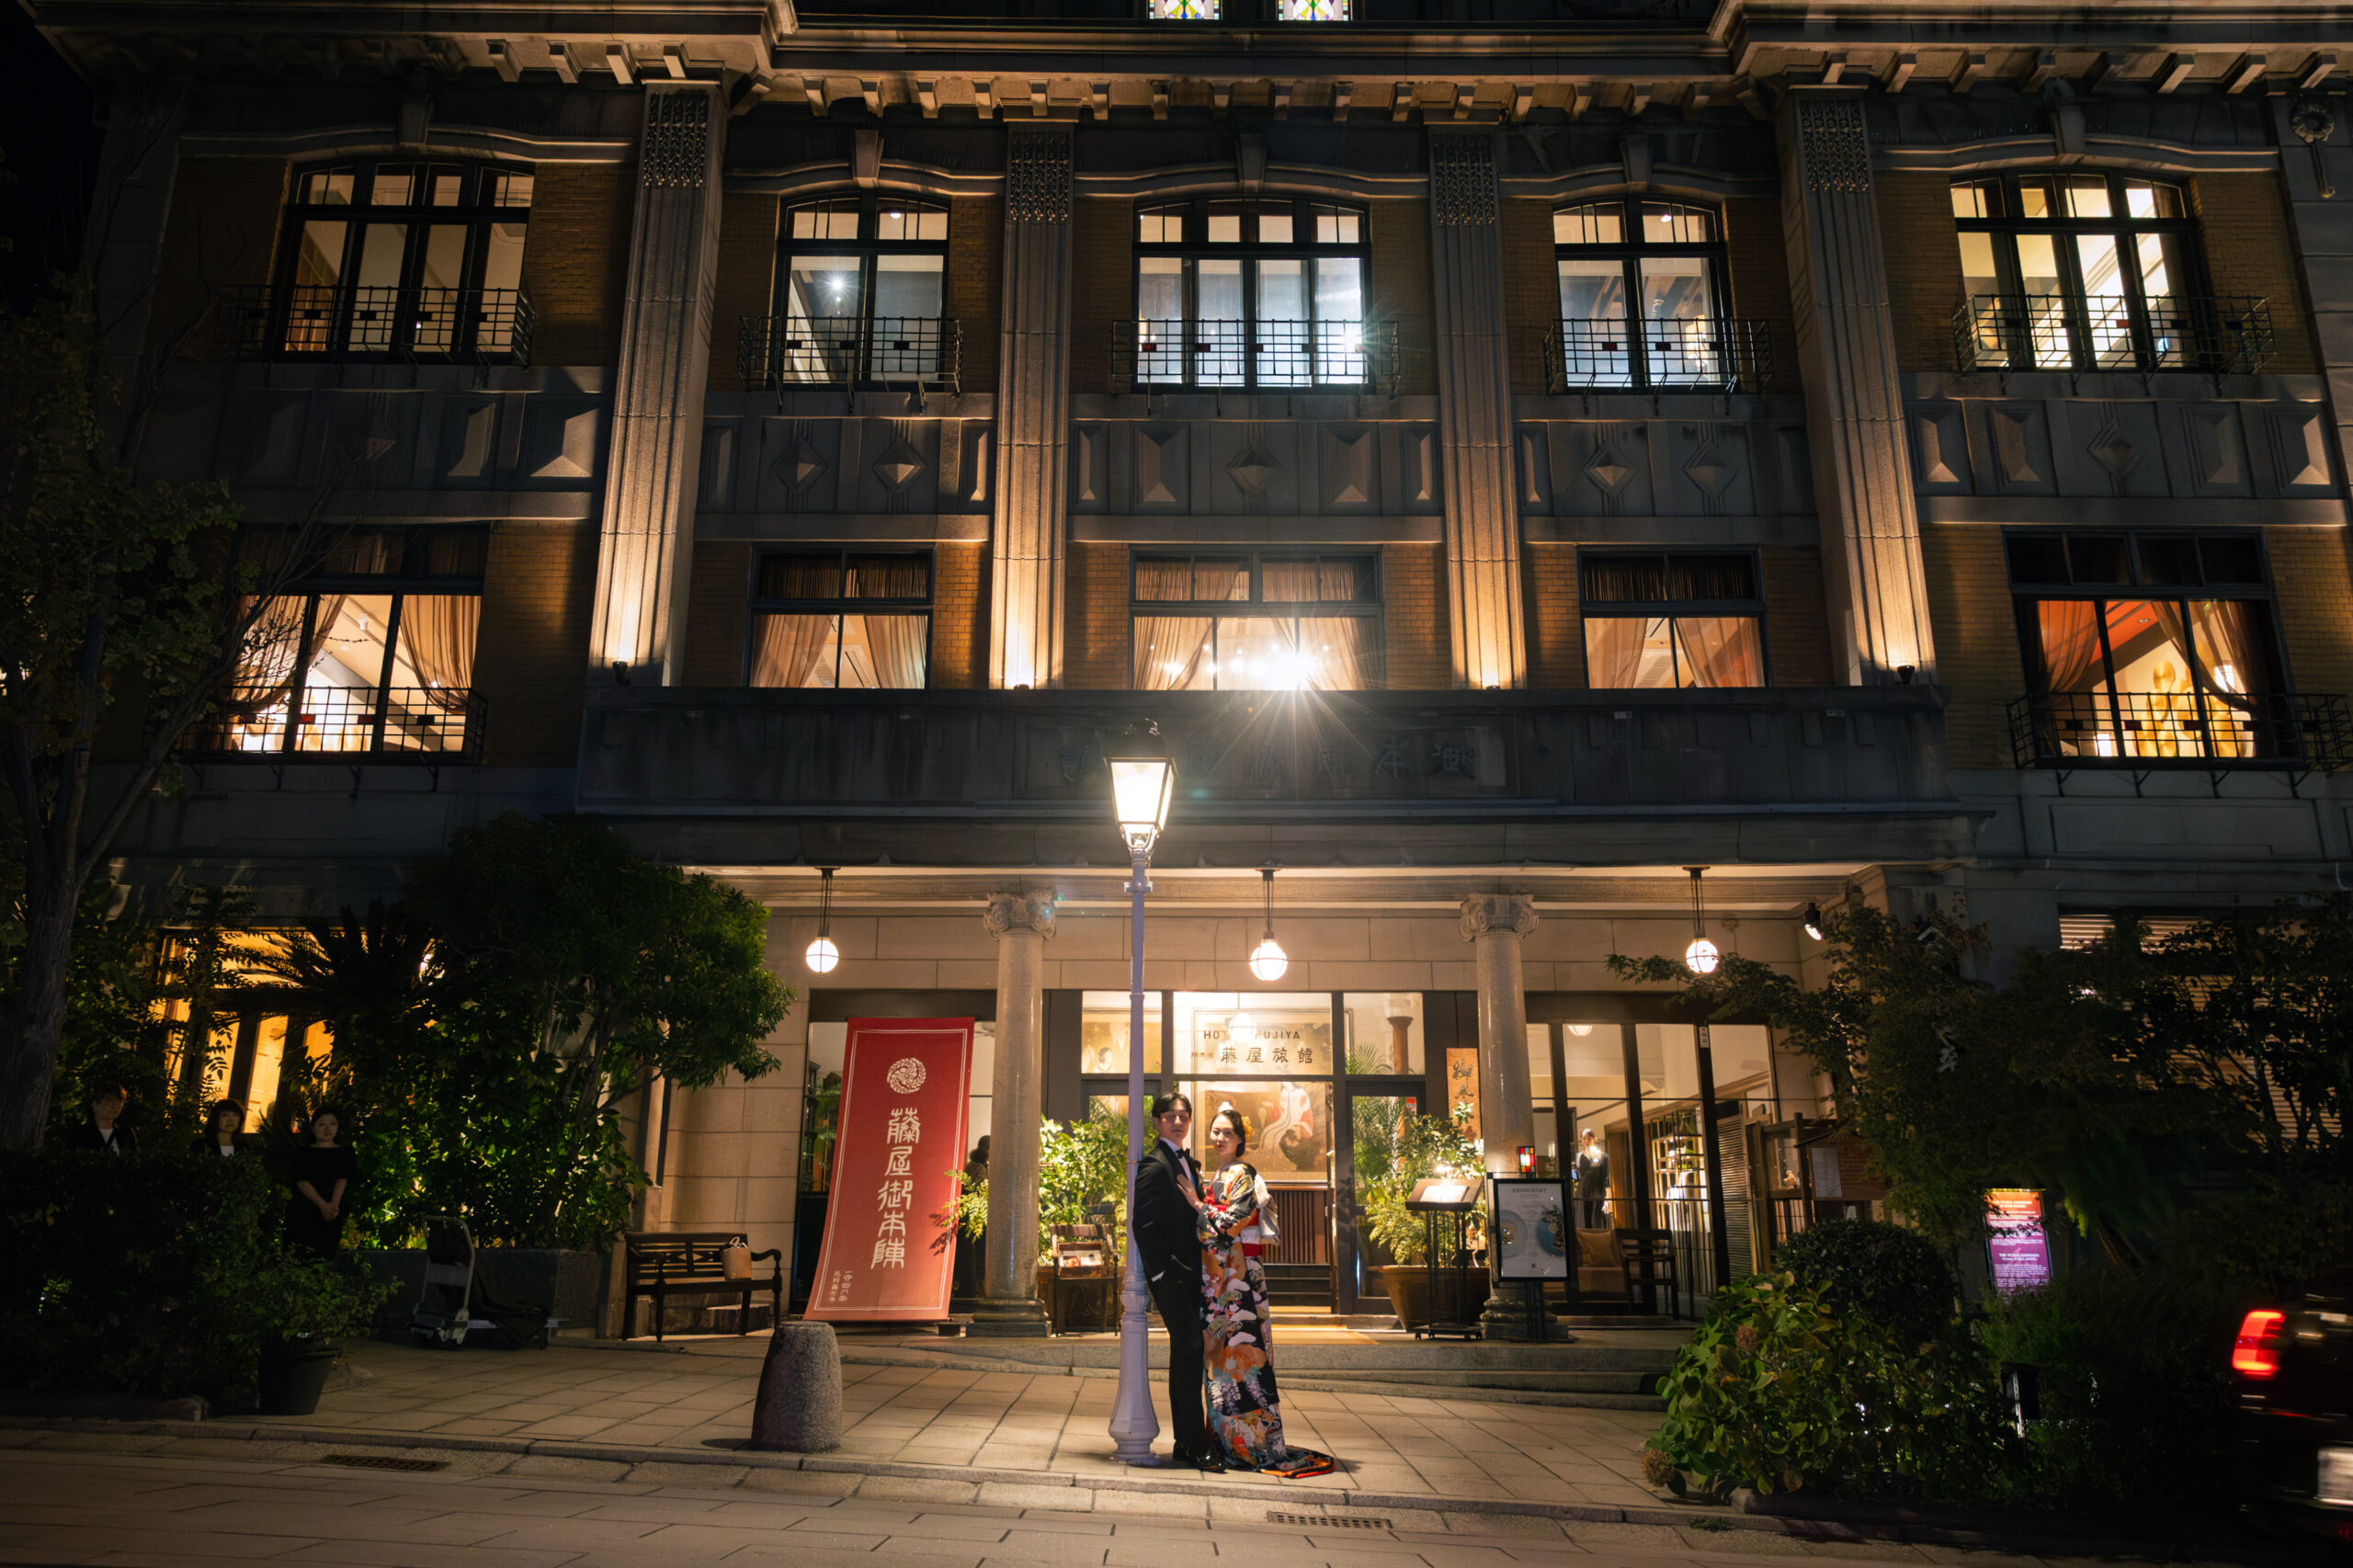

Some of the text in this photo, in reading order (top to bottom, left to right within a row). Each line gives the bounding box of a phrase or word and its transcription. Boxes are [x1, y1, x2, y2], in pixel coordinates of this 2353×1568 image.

[1255, 1030, 1301, 1040] FUJIYA
[1221, 1046, 1313, 1064] 藤屋旅館
